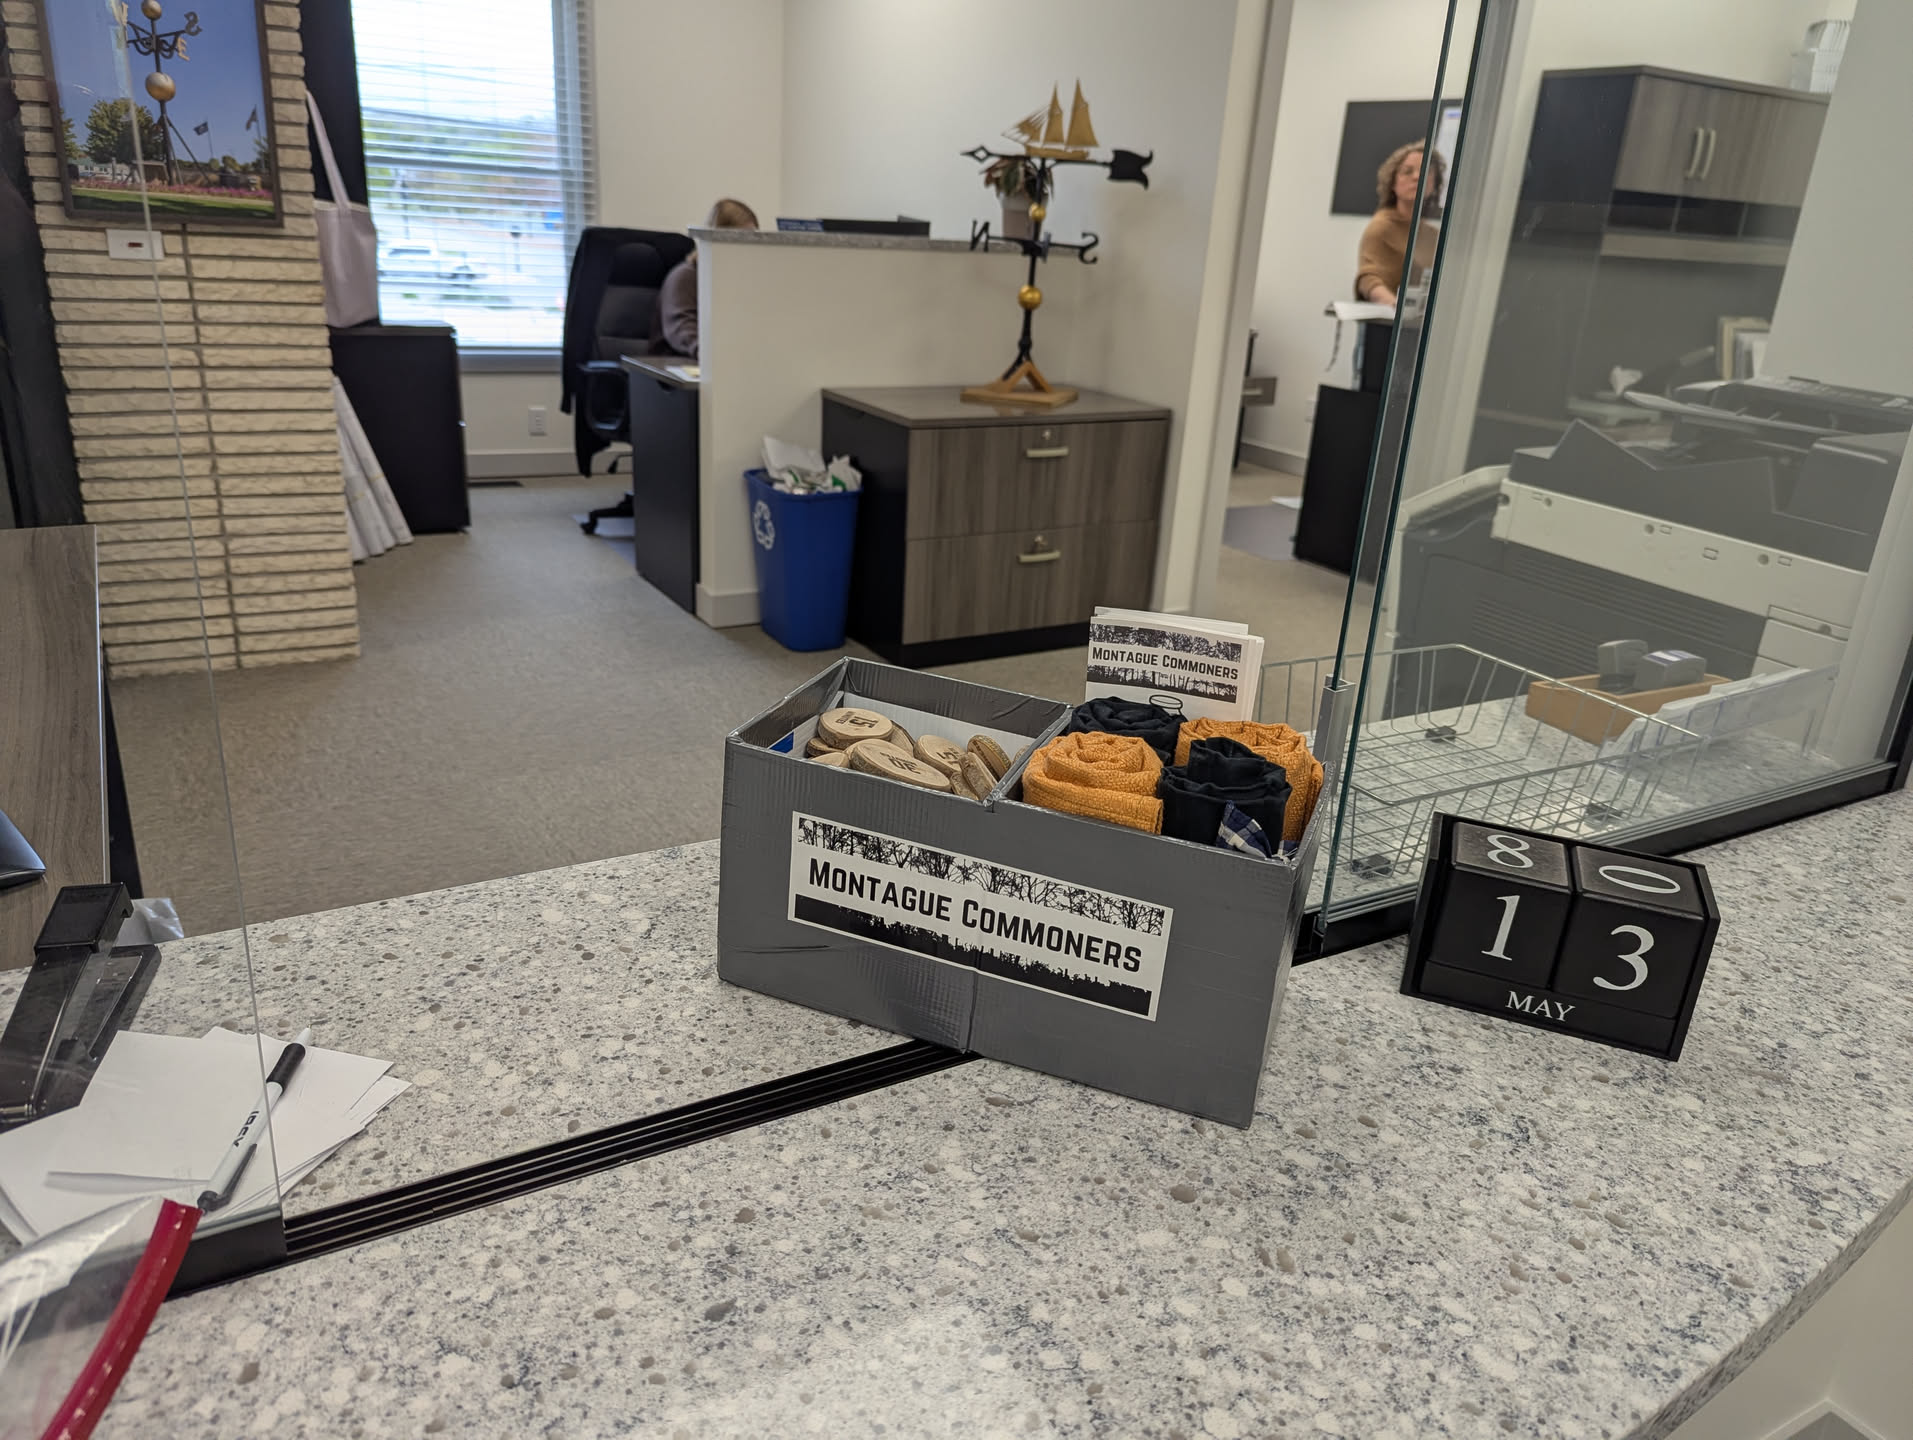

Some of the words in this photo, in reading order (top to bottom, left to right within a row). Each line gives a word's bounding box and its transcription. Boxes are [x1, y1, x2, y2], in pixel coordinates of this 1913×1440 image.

[1092, 647, 1158, 666] MONTAGUE
[1162, 654, 1238, 680] COMMONERS
[1487, 834, 1534, 868] 8
[809, 857, 952, 922] MONTAGUE
[961, 899, 1142, 973] COMMONERS
[1506, 991, 1576, 1022] MAY
